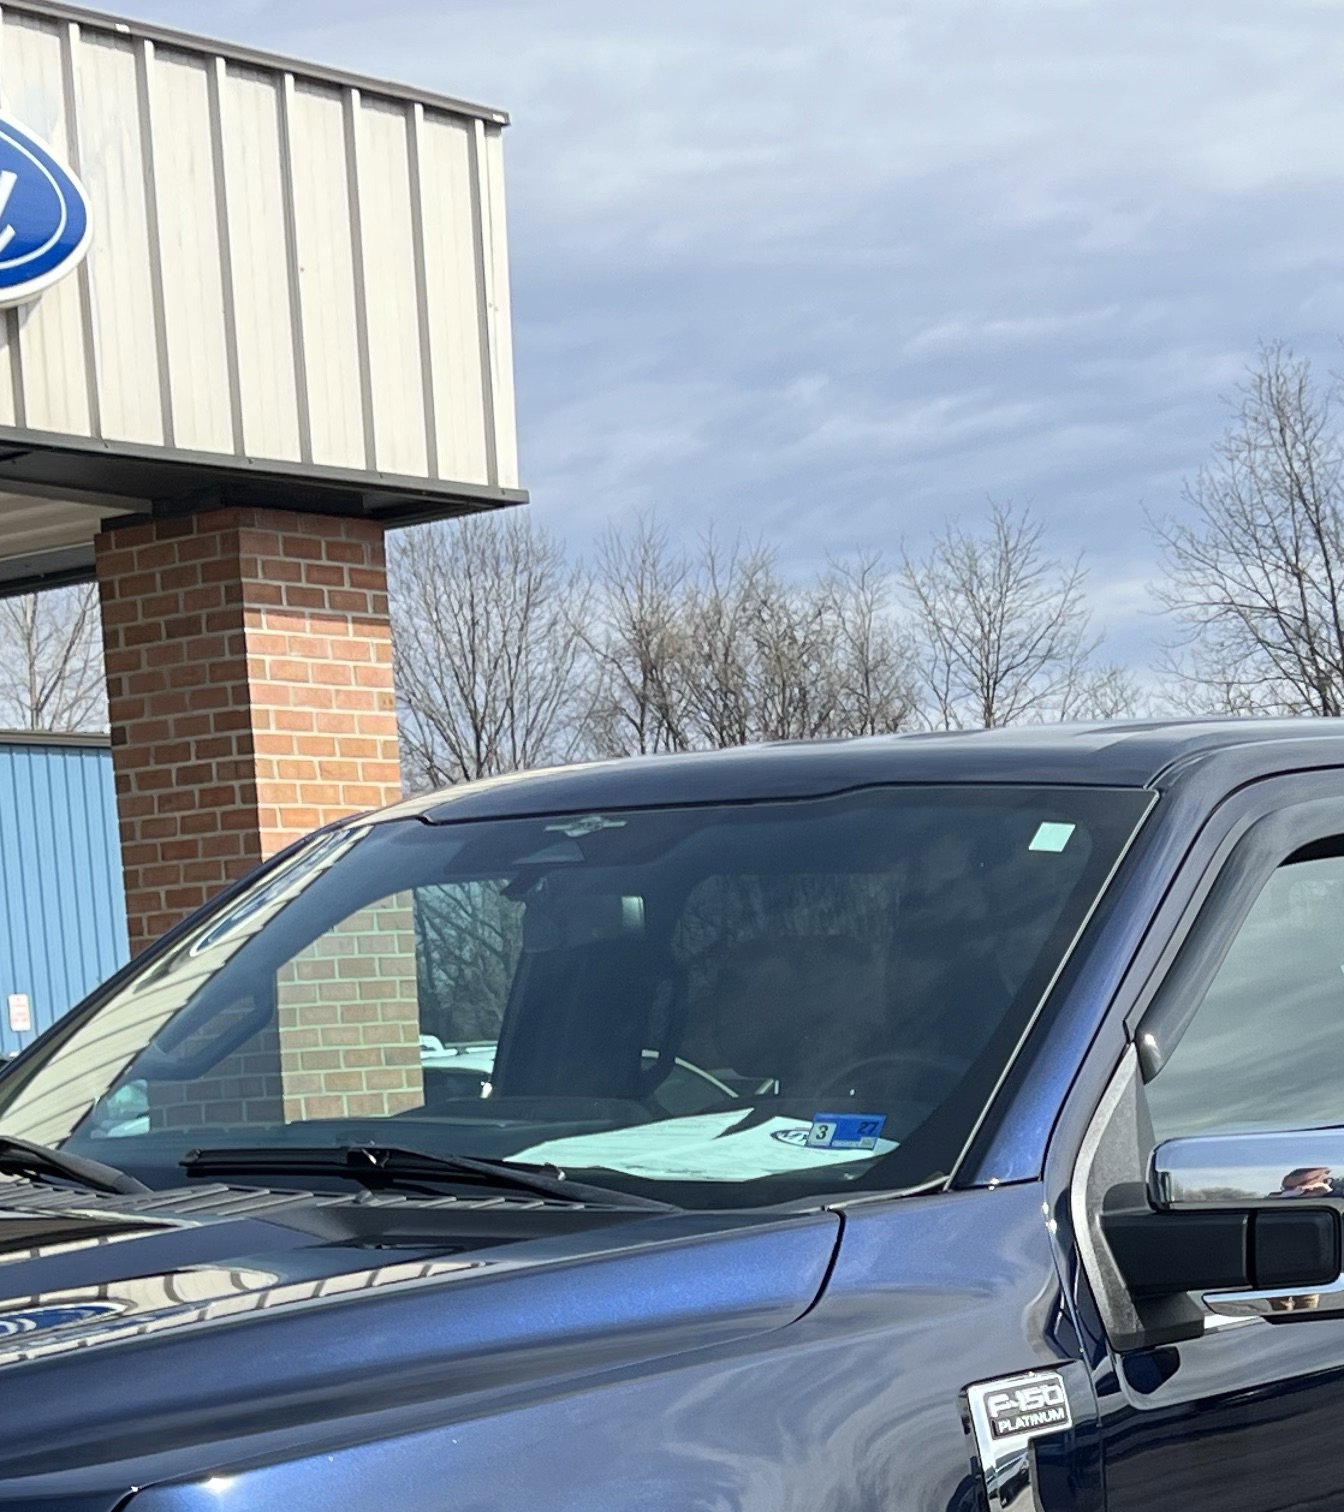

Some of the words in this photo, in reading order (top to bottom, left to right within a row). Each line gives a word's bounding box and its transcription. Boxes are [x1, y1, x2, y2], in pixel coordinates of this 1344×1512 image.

[815, 1124, 828, 1140] 3
[857, 1121, 879, 1136] 27
[987, 1384, 1065, 1418] F-150
[997, 1407, 1065, 1434] PLATINUM
